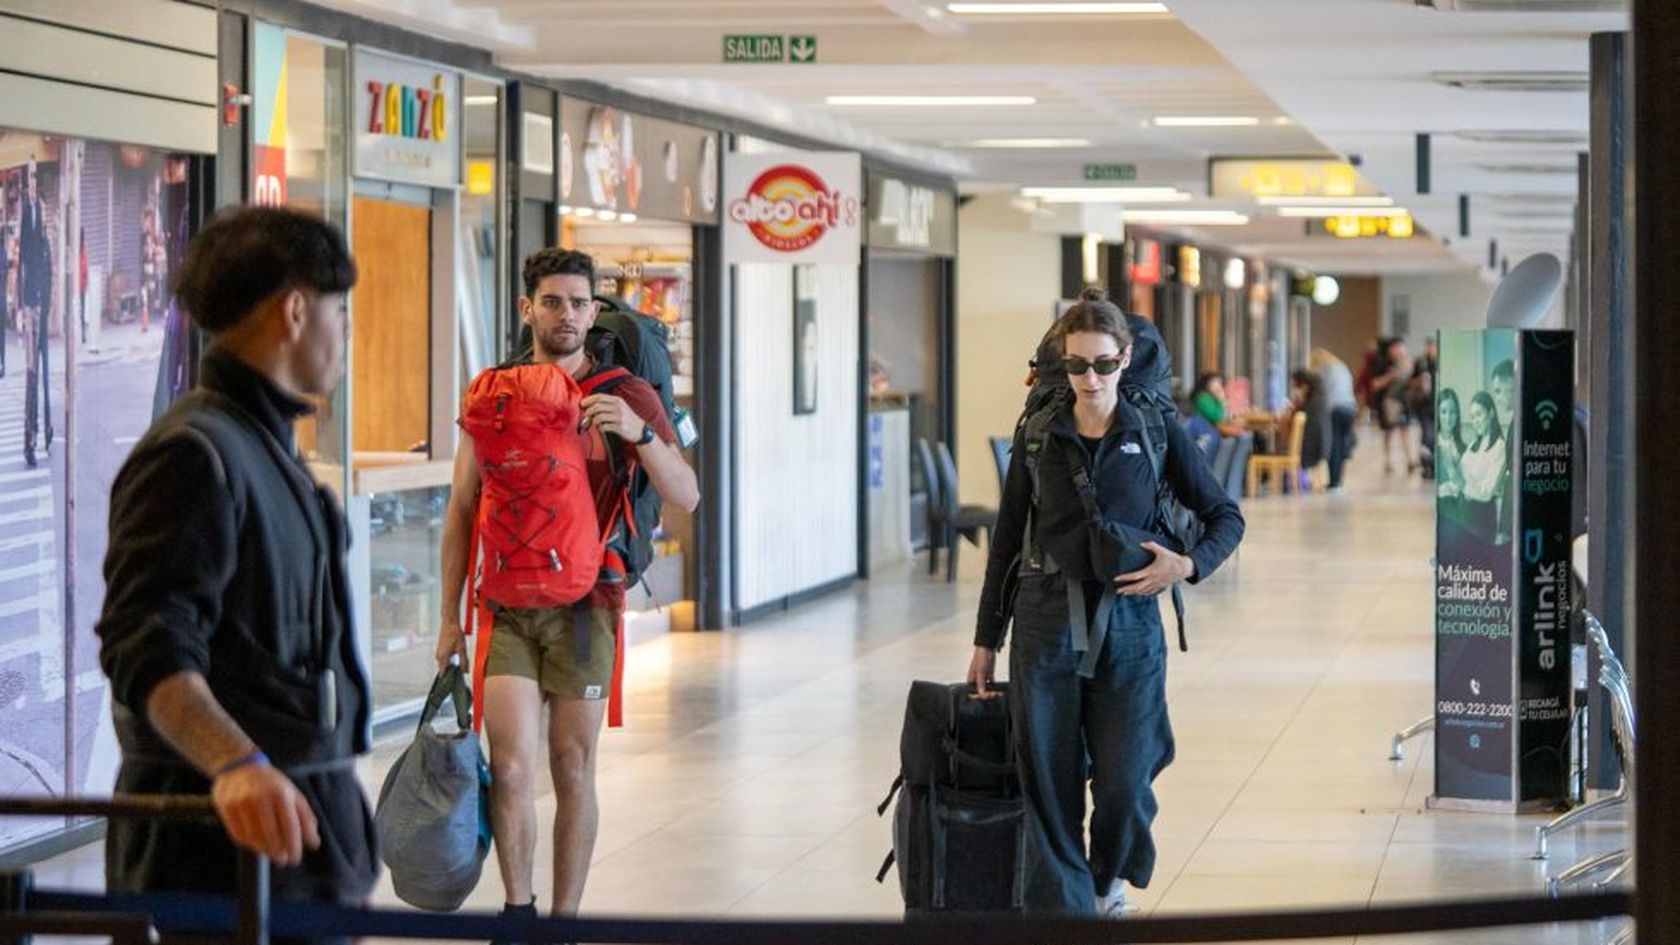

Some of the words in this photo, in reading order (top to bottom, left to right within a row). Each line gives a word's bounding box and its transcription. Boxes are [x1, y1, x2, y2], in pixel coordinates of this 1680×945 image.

[727, 37, 781, 58] SALIDA
[1523, 440, 1570, 457] Internet
[1525, 460, 1551, 477] para
[1553, 459, 1567, 475] tu
[1523, 478, 1569, 496] negocio
[1438, 565, 1492, 582] Máxima
[1438, 583, 1486, 600] calidad
[1489, 584, 1508, 601] de
[1438, 601, 1500, 618] conexión
[1503, 606, 1513, 621] y
[1534, 562, 1555, 670] arlink
